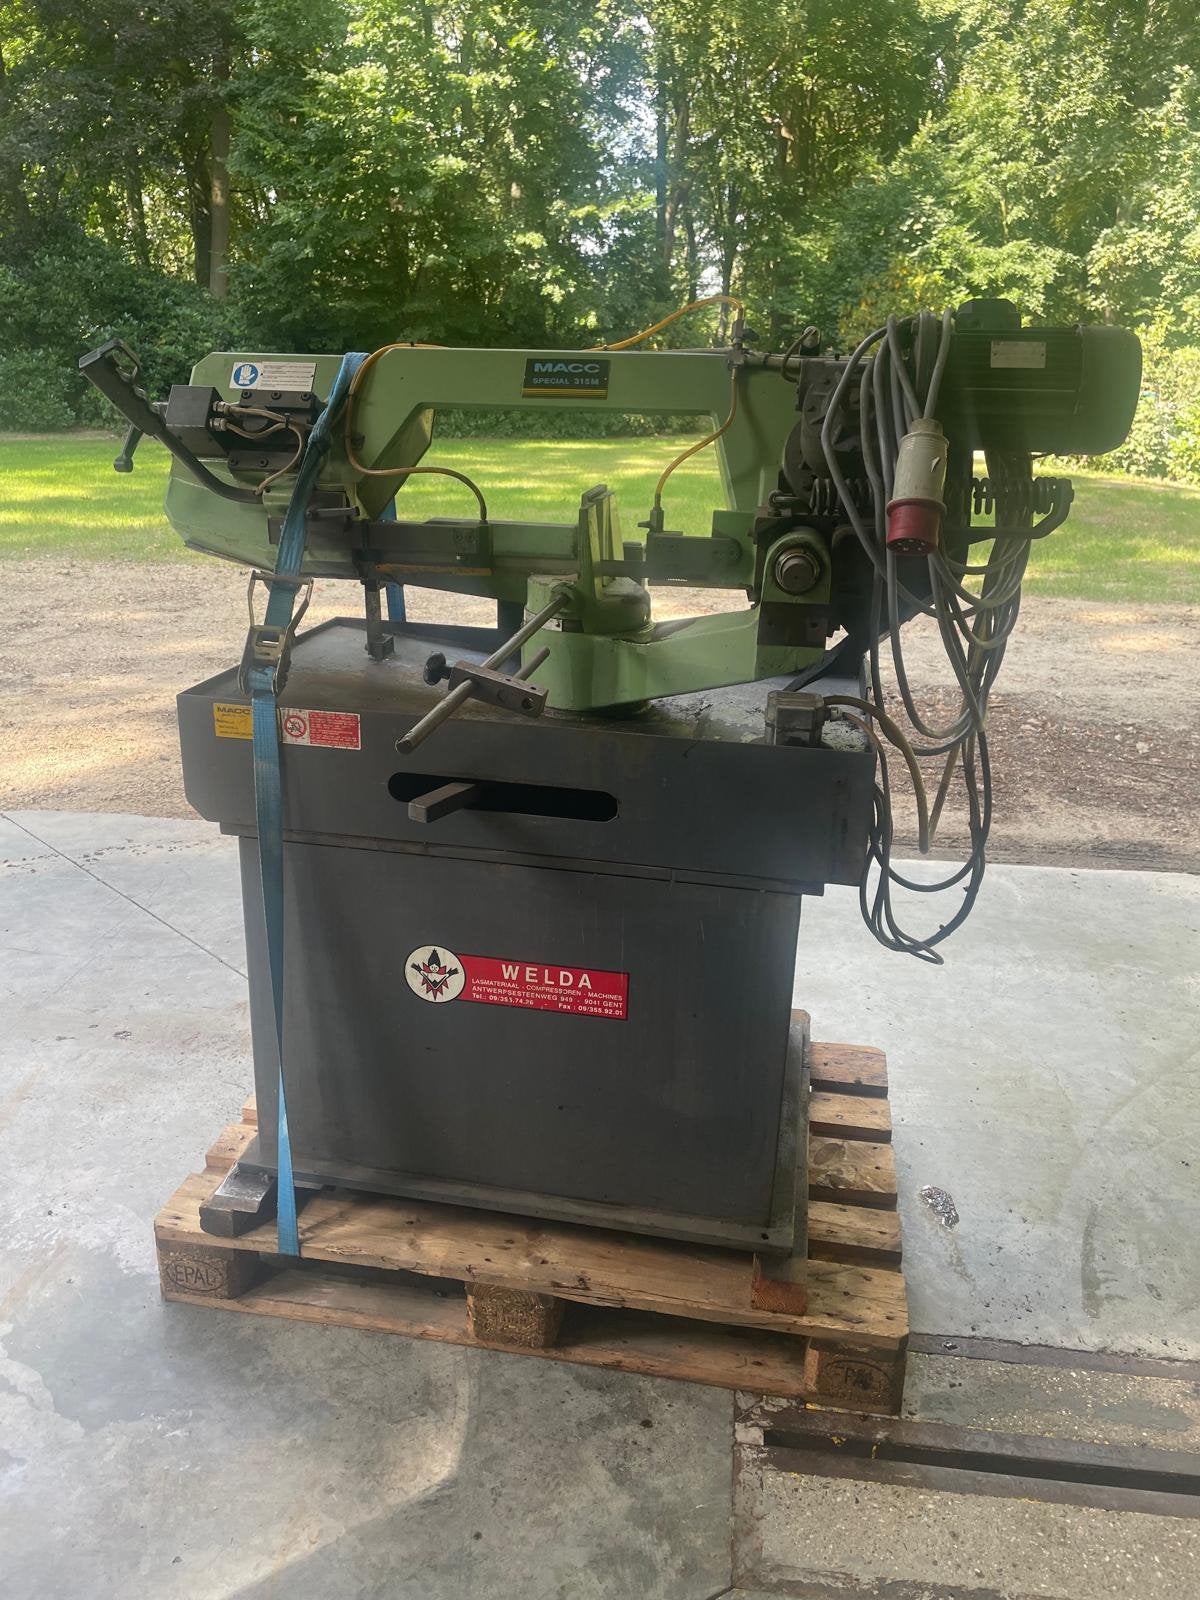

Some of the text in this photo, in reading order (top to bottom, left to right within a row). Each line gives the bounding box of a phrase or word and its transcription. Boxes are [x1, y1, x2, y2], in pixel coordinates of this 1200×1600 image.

[534, 363, 600, 373] MACC
[532, 377, 570, 385] SPECIAL
[501, 963, 592, 989] WELDA
[471, 979, 519, 989] LASMATERIAAL
[526, 984, 581, 996] COMPRESSOREN
[588, 991, 623, 1001] MACHINES
[472, 986, 558, 1001] ANTWERPSESTEENWEG
[584, 998, 600, 1006] 9041
[174, 1264, 214, 1287] EPAL
